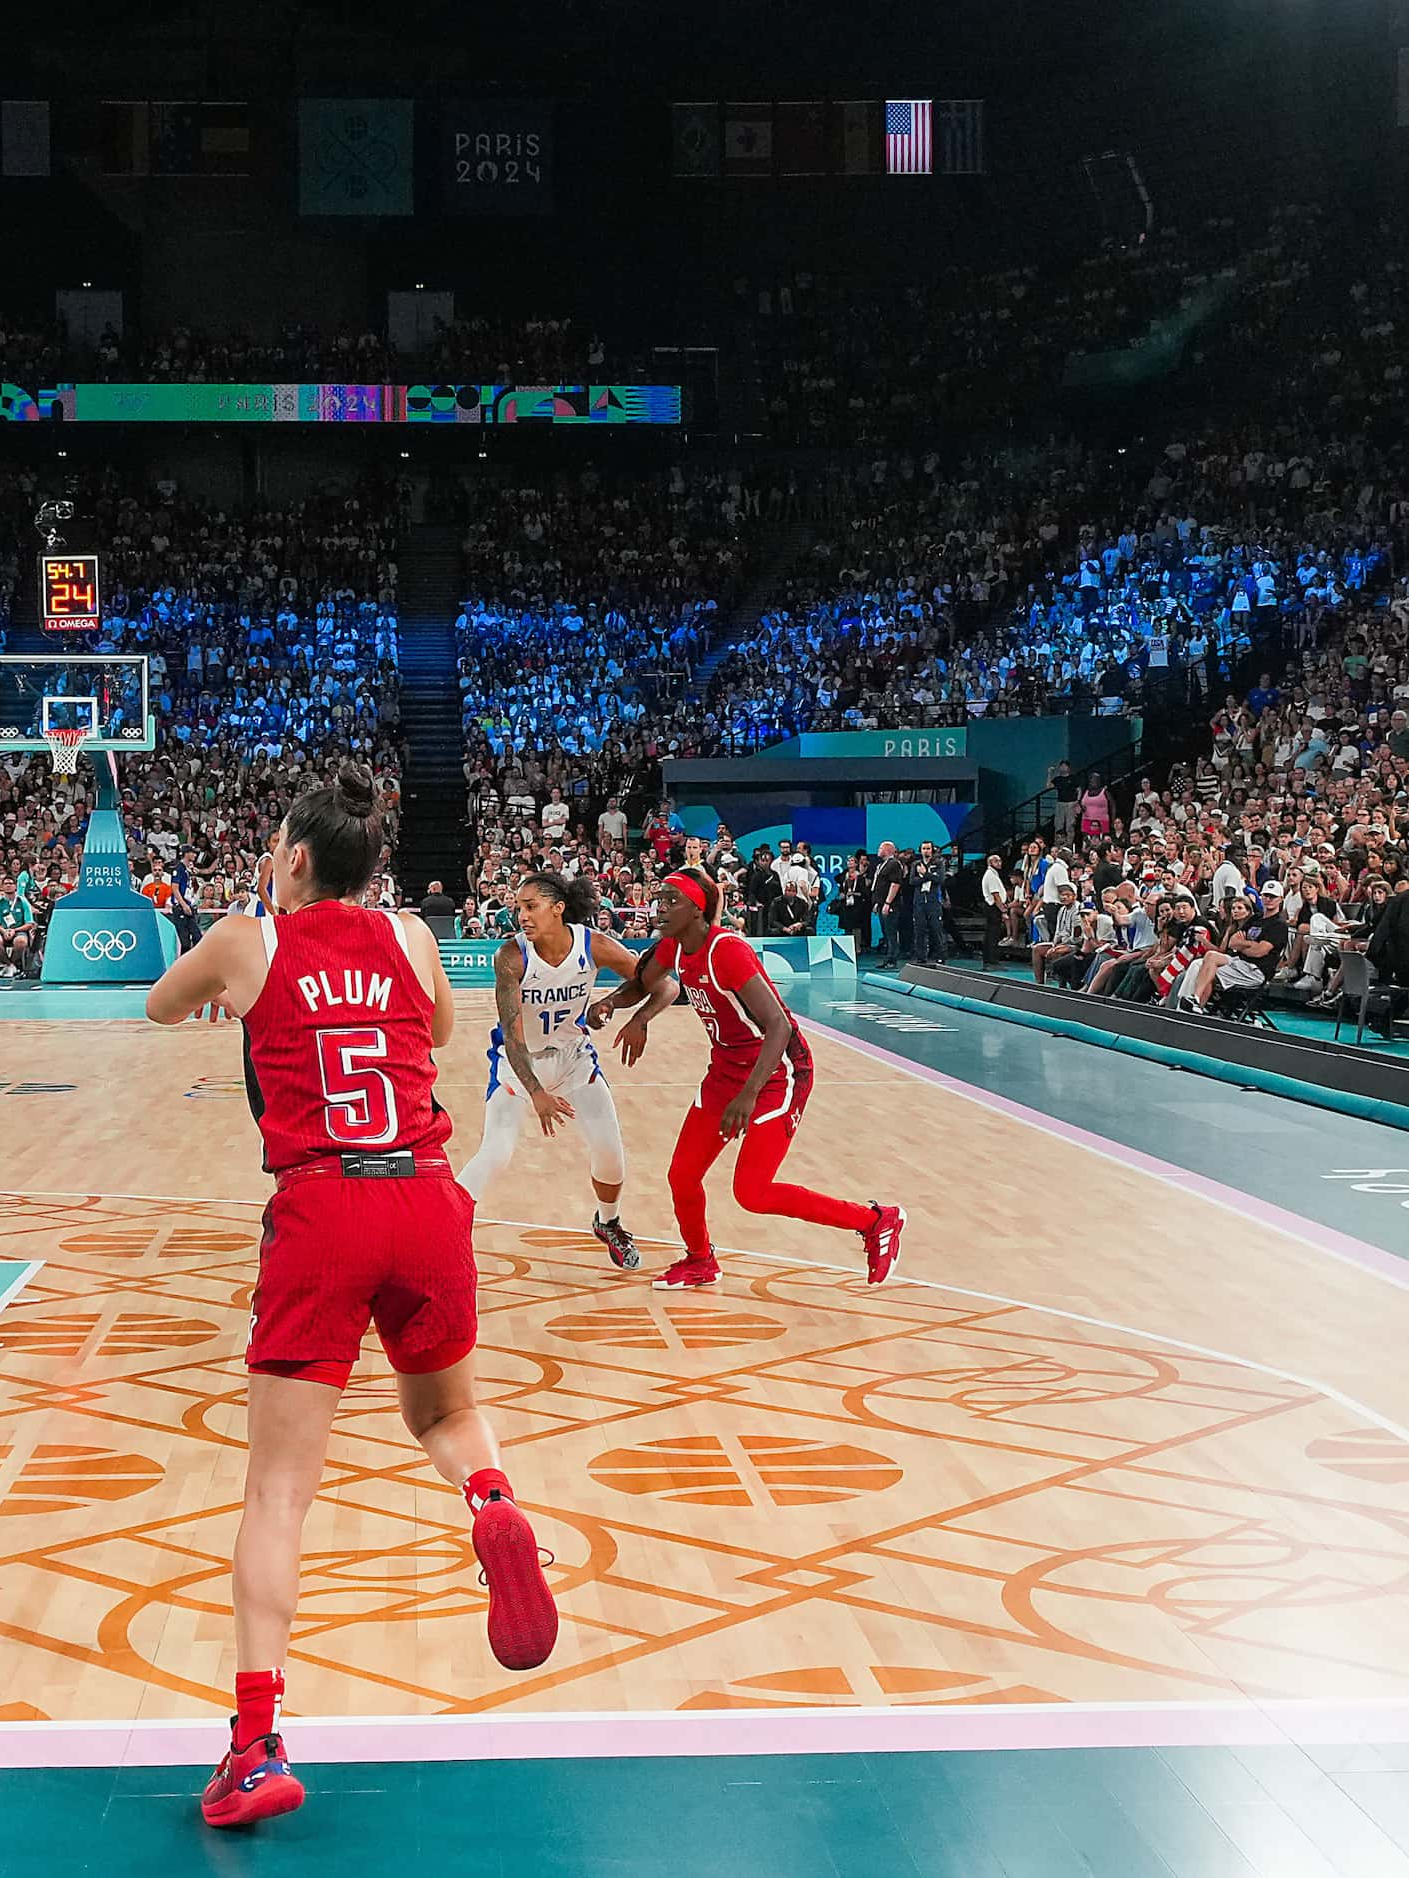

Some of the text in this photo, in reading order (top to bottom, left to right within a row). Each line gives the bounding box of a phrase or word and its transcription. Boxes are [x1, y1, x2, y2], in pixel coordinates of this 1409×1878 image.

[455, 160, 540, 183] 2024
[47, 563, 84, 579] 54.7
[51, 583, 92, 612] 24
[58, 619, 96, 628] OMEGA
[85, 866, 122, 876] PARIS
[86, 877, 122, 887] 2024
[450, 954, 495, 967] PARI
[297, 969, 393, 1012] PLUM
[521, 982, 587, 1004] FRANCE
[316, 1028, 399, 1145] 5
